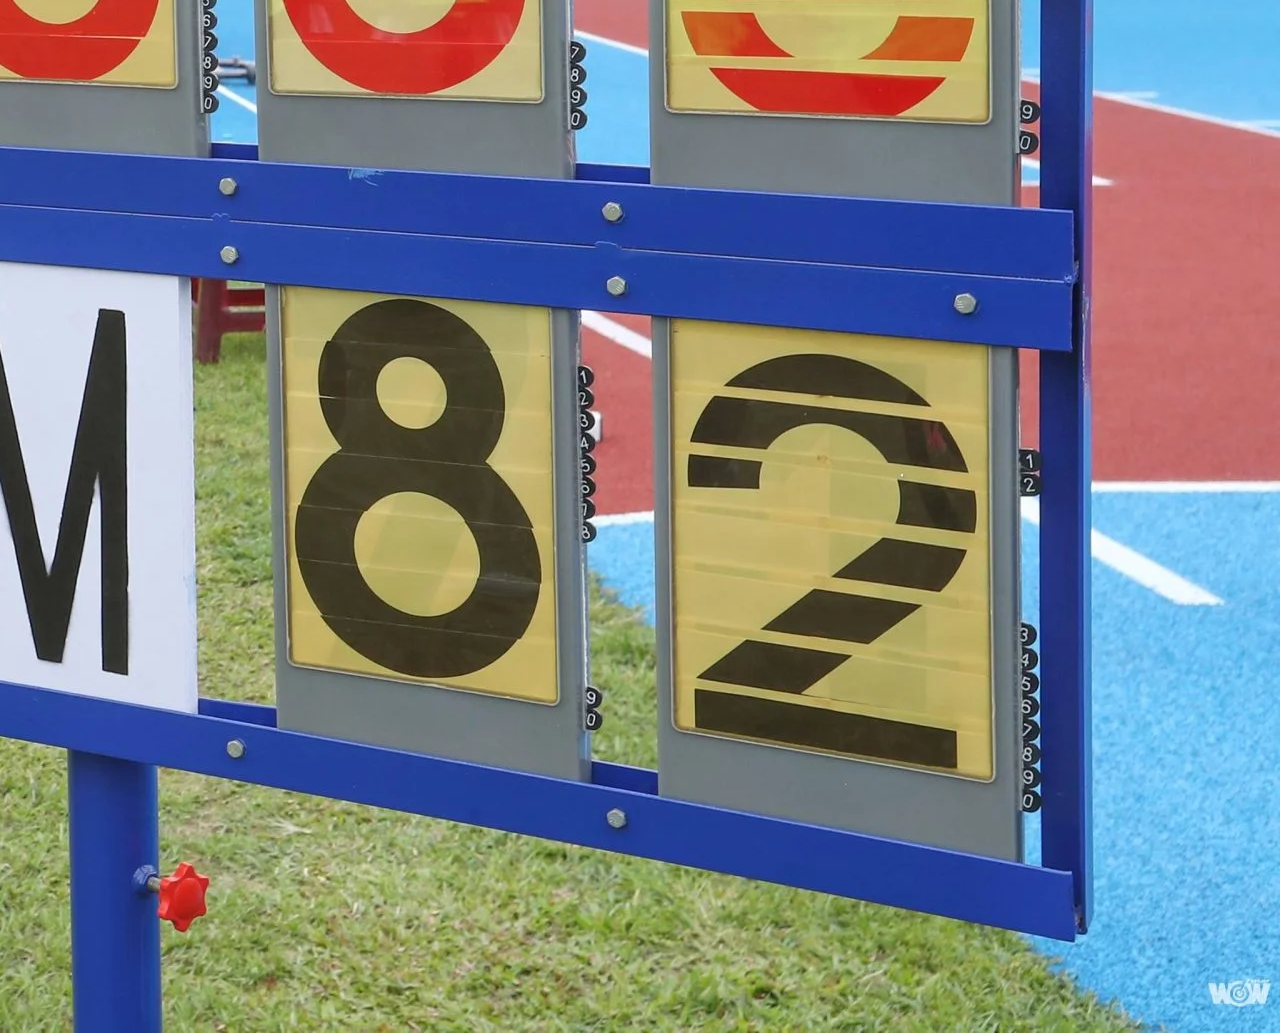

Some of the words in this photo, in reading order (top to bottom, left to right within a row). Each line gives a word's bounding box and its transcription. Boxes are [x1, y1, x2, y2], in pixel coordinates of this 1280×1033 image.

[203, 14, 210, 26] 6
[204, 36, 211, 47] 7
[571, 46, 579, 58] 7
[204, 56, 210, 68] 8
[571, 69, 579, 82] 8
[205, 76, 212, 88] 9
[205, 97, 212, 109] 0
[571, 91, 580, 103] 9
[1022, 105, 1033, 119] 9
[571, 113, 580, 125] 0
[1020, 136, 1030, 149] 0
[580, 371, 586, 384] 1
[579, 392, 588, 405] 2
[580, 416, 588, 427] 3
[581, 437, 588, 449] 4
[582, 459, 589, 472] 5
[1027, 454, 1032, 468] 1
[294, 298, 542, 679] 8
[582, 481, 589, 493] 6
[1024, 478, 1035, 492] 2
[582, 504, 587, 516] 7
[582, 527, 590, 538] 8
[1021, 628, 1028, 641] 3
[1022, 654, 1029, 666] 4
[1022, 677, 1030, 690] 5
[587, 692, 596, 704] 9
[1022, 700, 1031, 713] 6
[587, 714, 595, 725] 0
[1023, 724, 1031, 736] 7
[1022, 747, 1032, 761] 8
[1023, 770, 1033, 784] 9
[1023, 794, 1033, 808] 0
